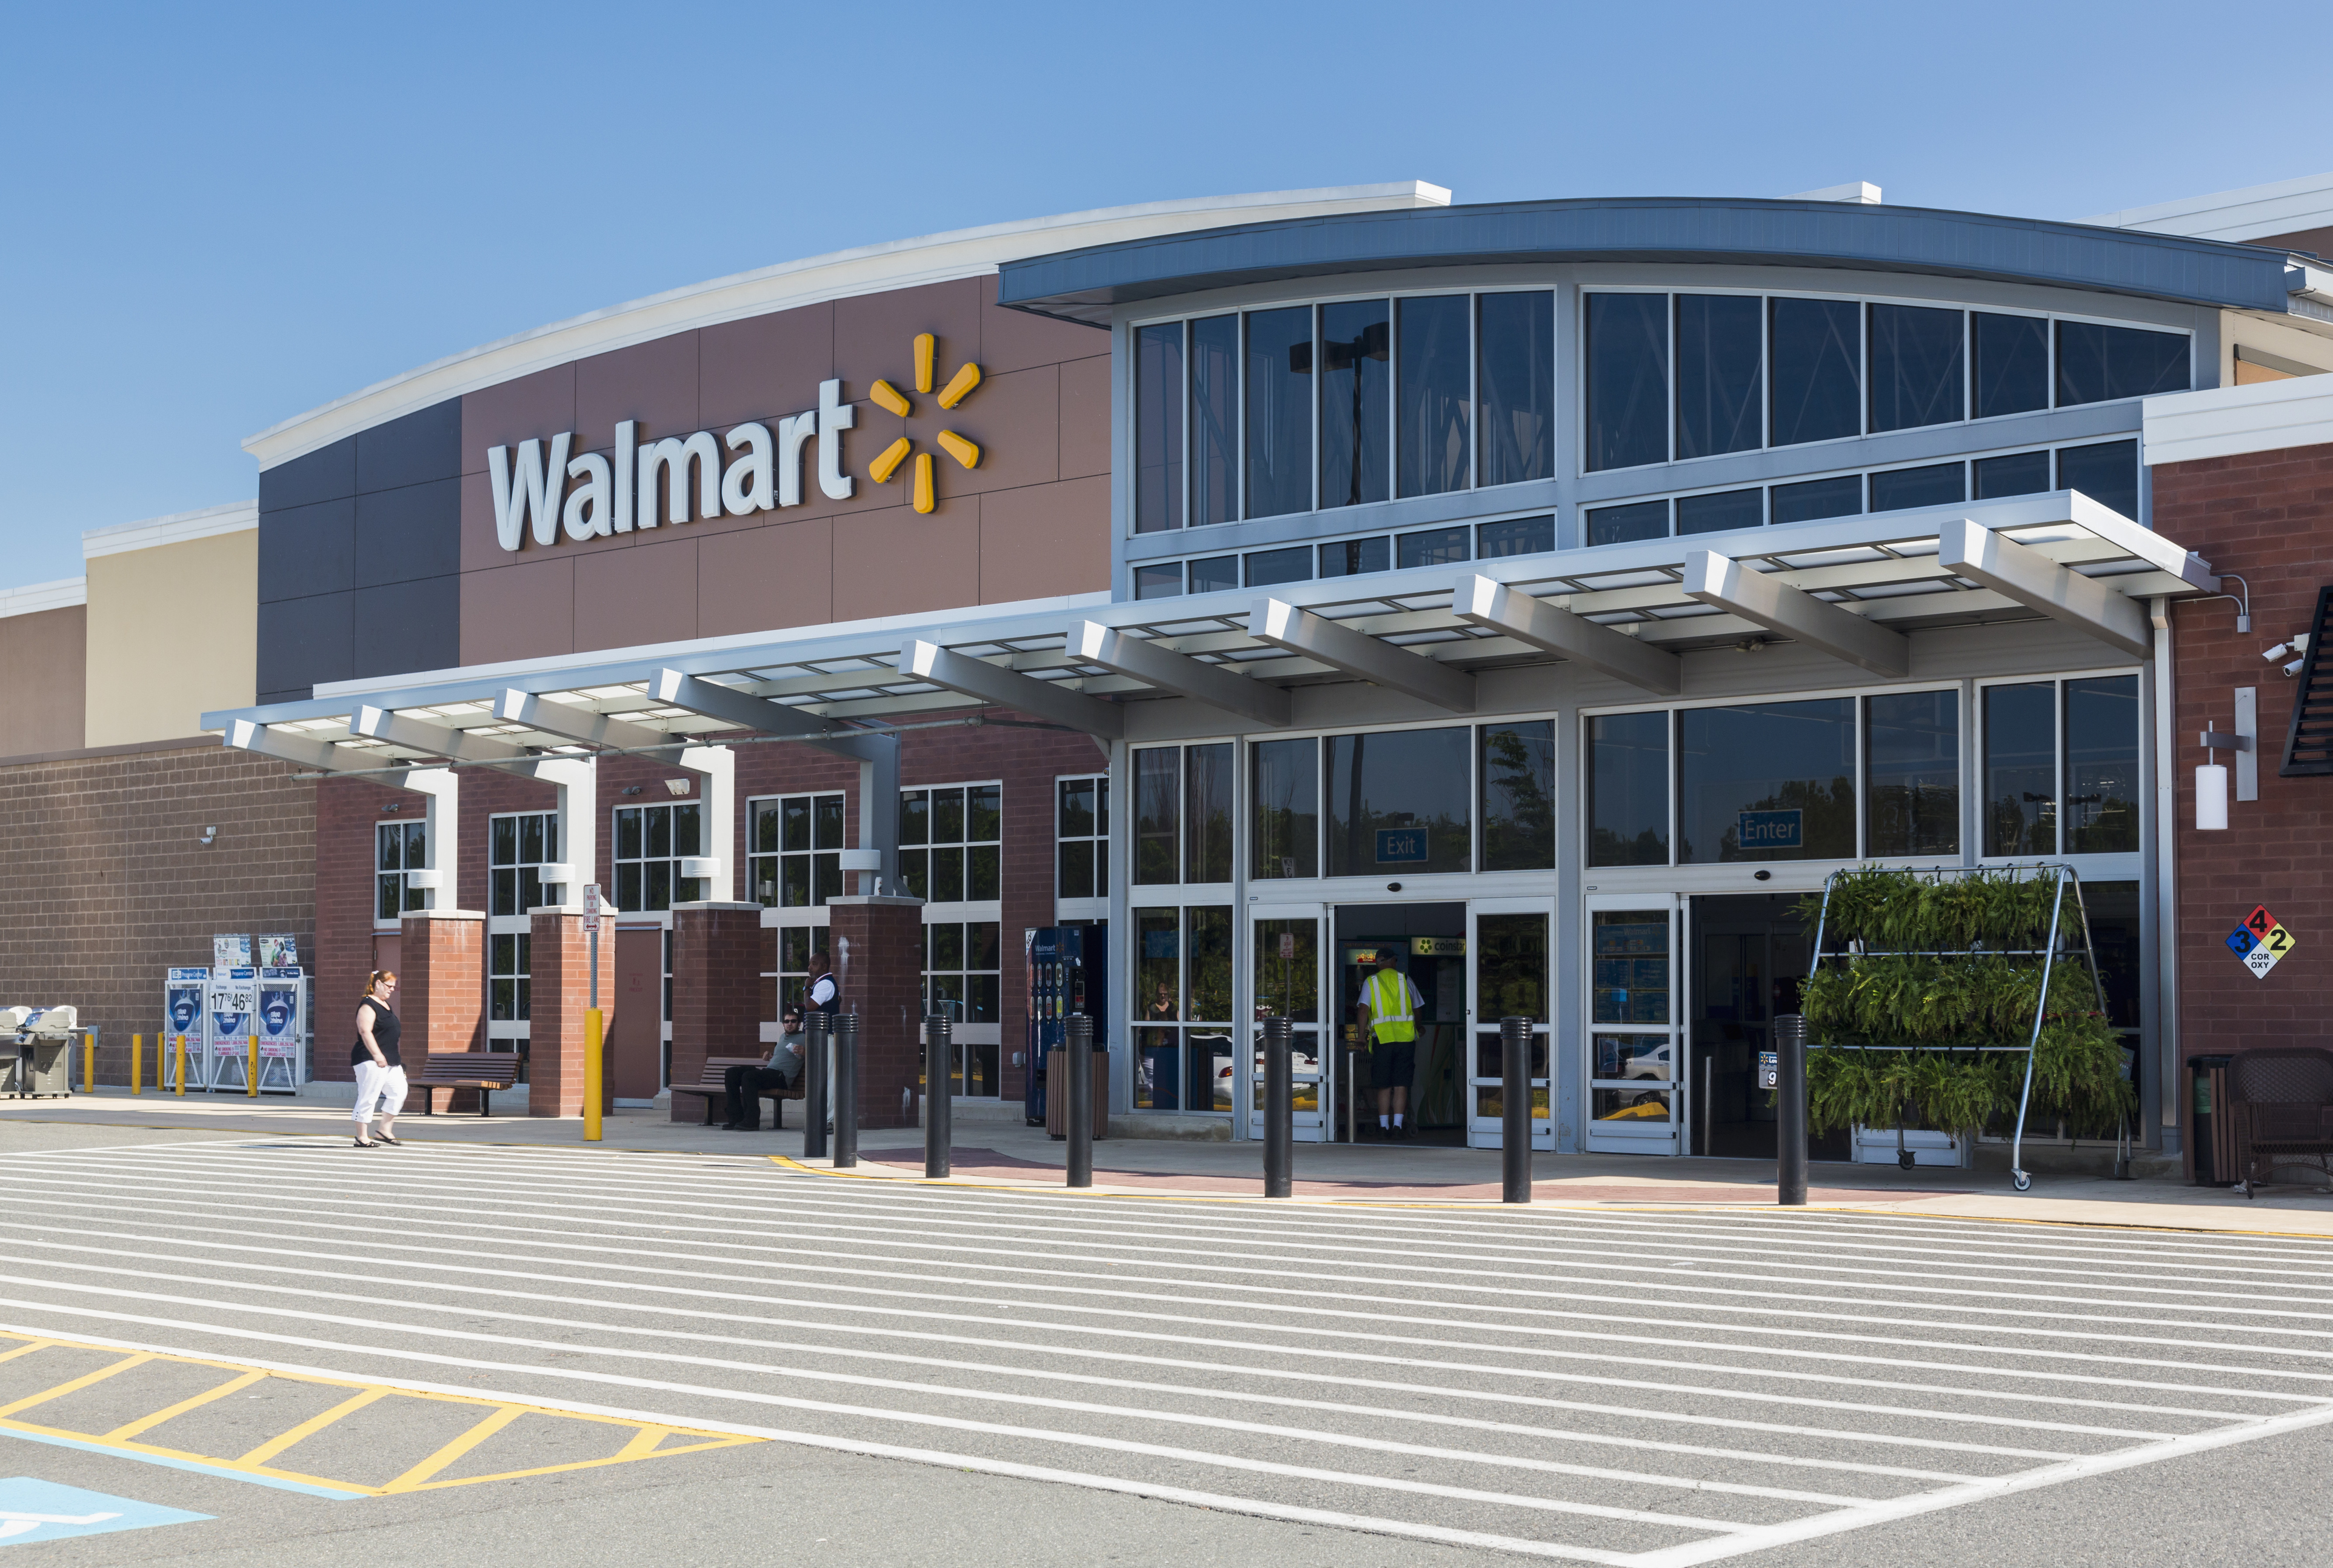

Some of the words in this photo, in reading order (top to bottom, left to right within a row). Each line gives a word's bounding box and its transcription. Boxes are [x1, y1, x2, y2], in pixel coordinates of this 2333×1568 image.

[487, 378, 856, 552] Walmart
[1744, 822, 1796, 840] Enter
[1387, 837, 1416, 855] Exit
[2249, 910, 2268, 933] 4
[1624, 927, 1650, 935] Walmart
[2270, 929, 2287, 951] 2
[1434, 940, 1464, 951] coinstar
[2234, 930, 2251, 953] 3
[1768, 1072, 1777, 1085] 9
